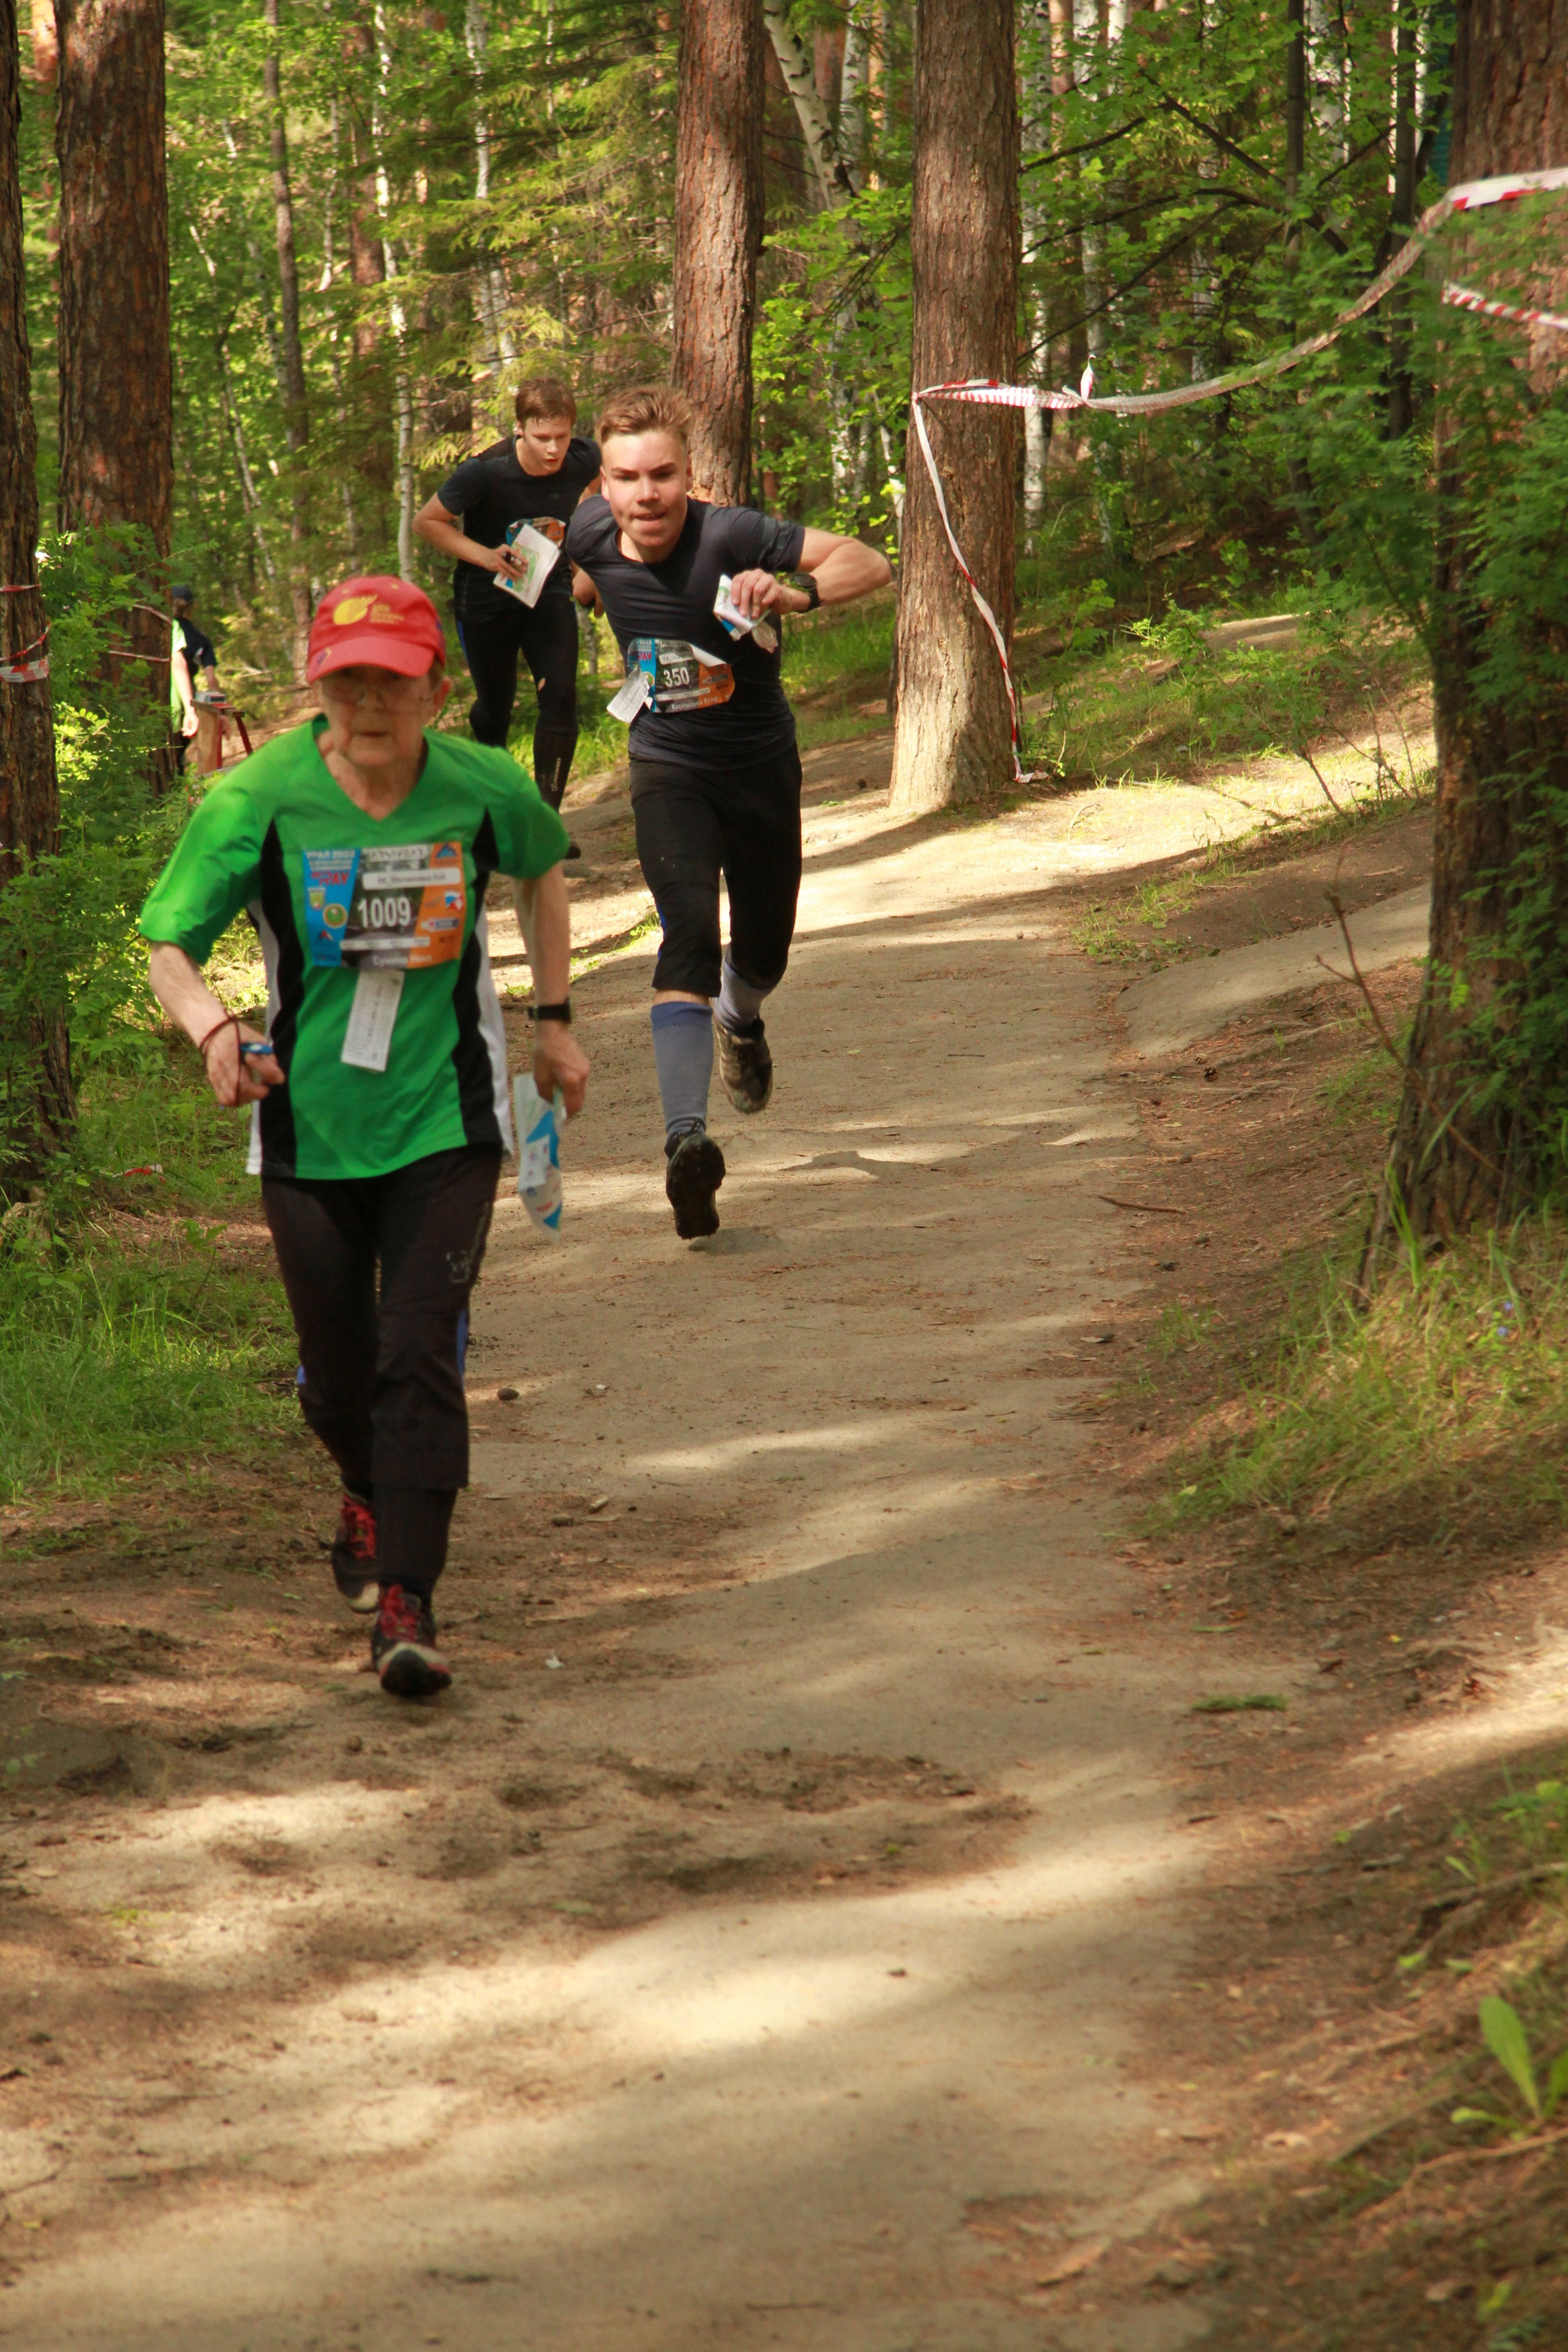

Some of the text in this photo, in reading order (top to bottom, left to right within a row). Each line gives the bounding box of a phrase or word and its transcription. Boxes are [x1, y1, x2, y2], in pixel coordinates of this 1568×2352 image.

[663, 667, 690, 687] 350
[704, 696, 718, 704] Егор
[357, 896, 412, 929] 1009
